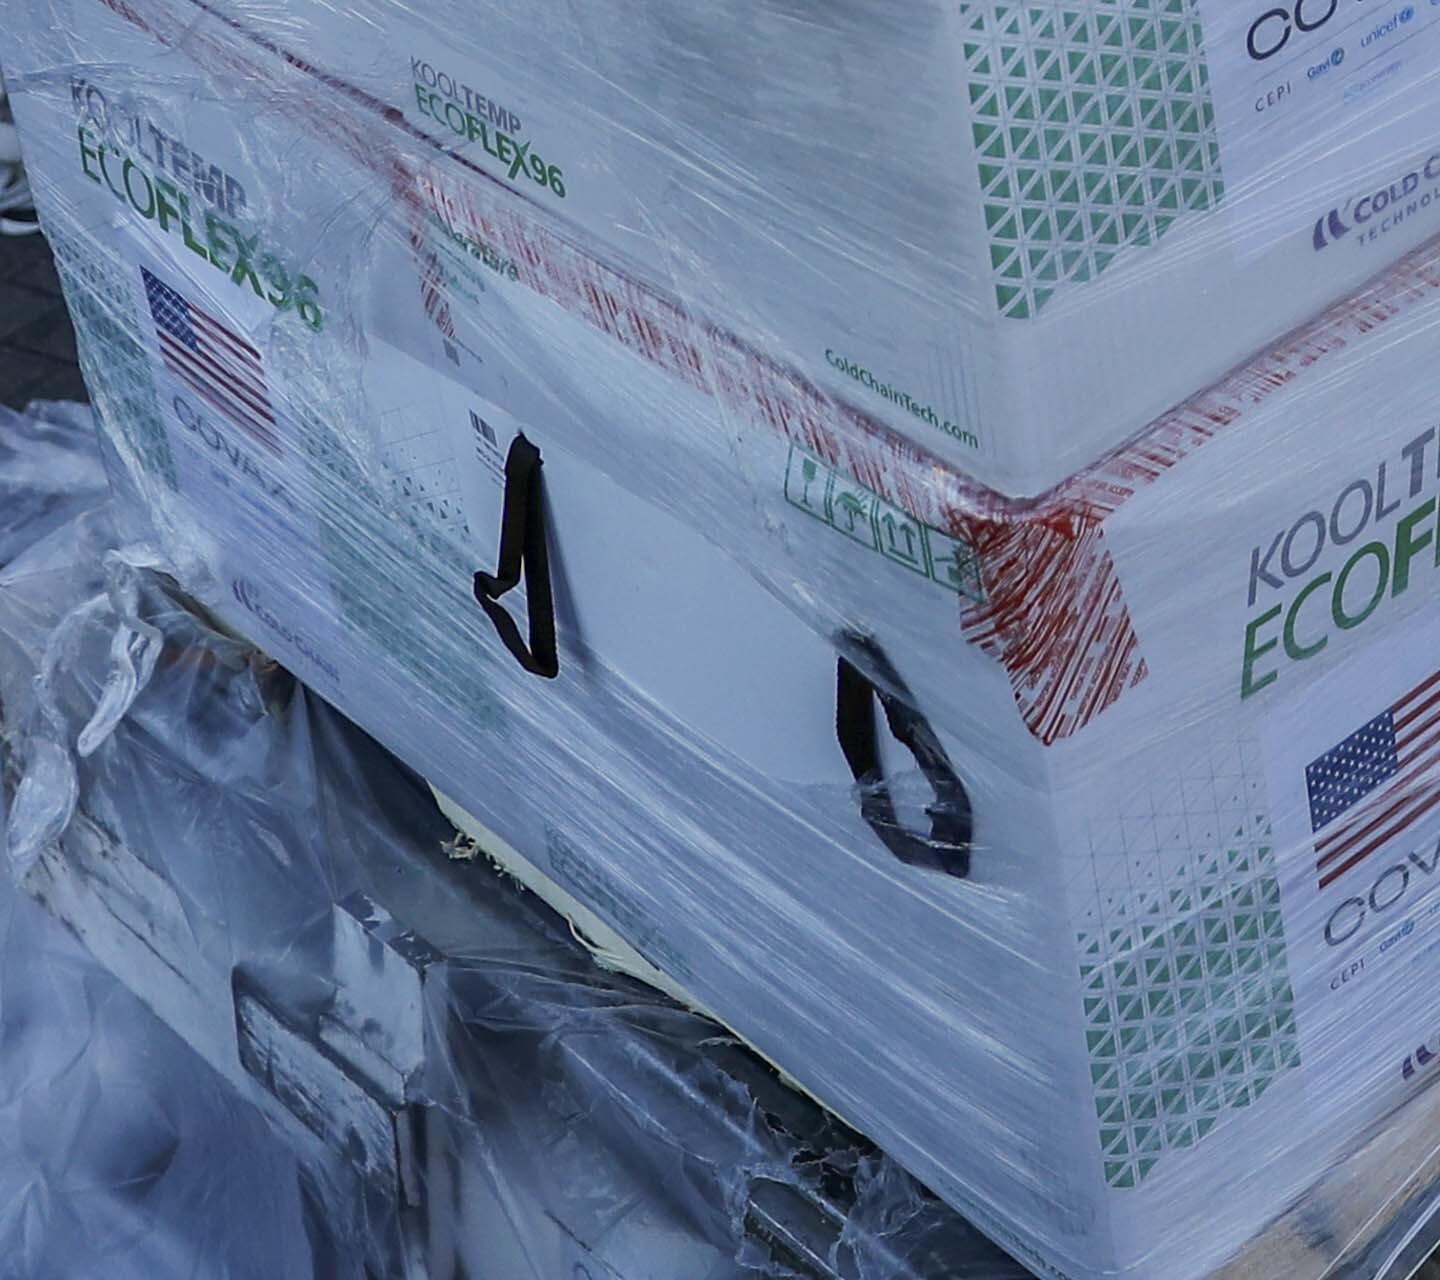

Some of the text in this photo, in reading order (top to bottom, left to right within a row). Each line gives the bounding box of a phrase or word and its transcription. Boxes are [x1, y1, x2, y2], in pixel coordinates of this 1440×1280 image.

[409, 55, 523, 136] KOOLTEMP
[1254, 80, 1293, 113] CEPI
[414, 81, 568, 200] ECOFLEX96
[1352, 171, 1420, 225] COLD
[824, 348, 981, 450] ColdChainTech.com
